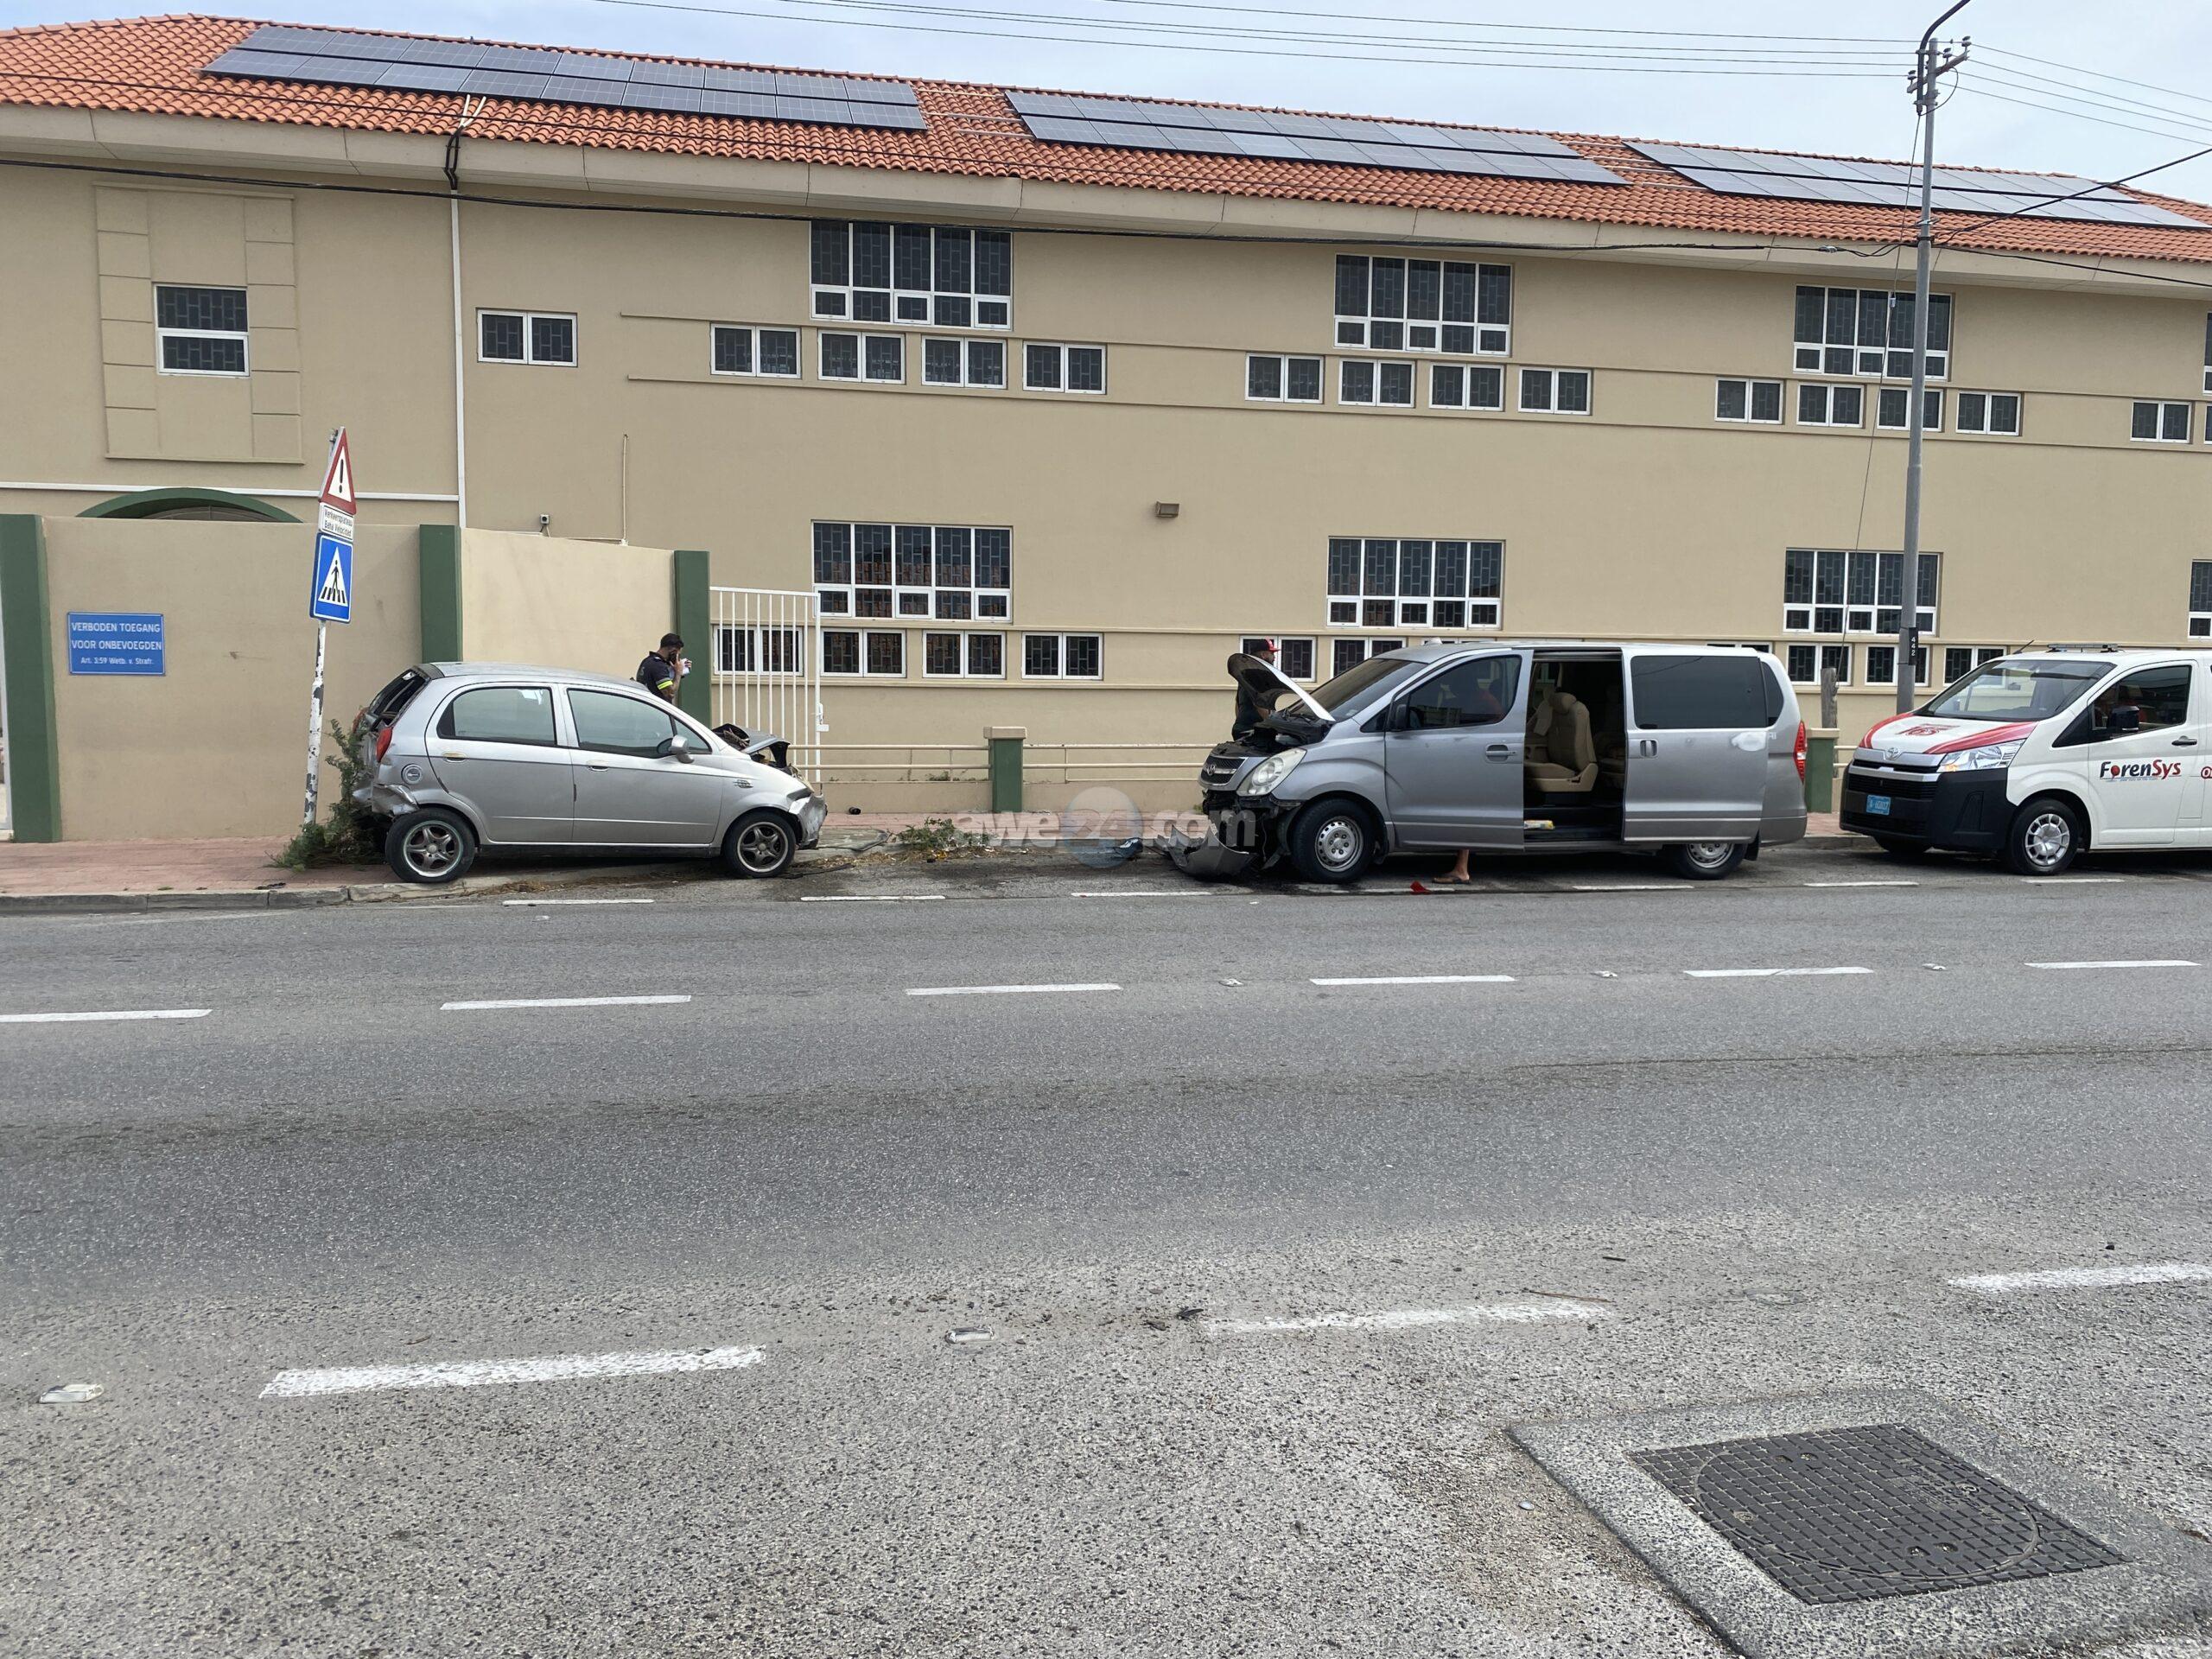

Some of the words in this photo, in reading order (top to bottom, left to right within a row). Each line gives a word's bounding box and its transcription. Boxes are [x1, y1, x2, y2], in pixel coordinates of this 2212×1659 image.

[71, 622, 118, 632] VERBODEN
[119, 623, 161, 632] TOEGANG
[71, 639, 97, 650] VOOR
[99, 640, 162, 651] ONBEVOEGDEN
[2099, 759, 2182, 780] ForenSys
